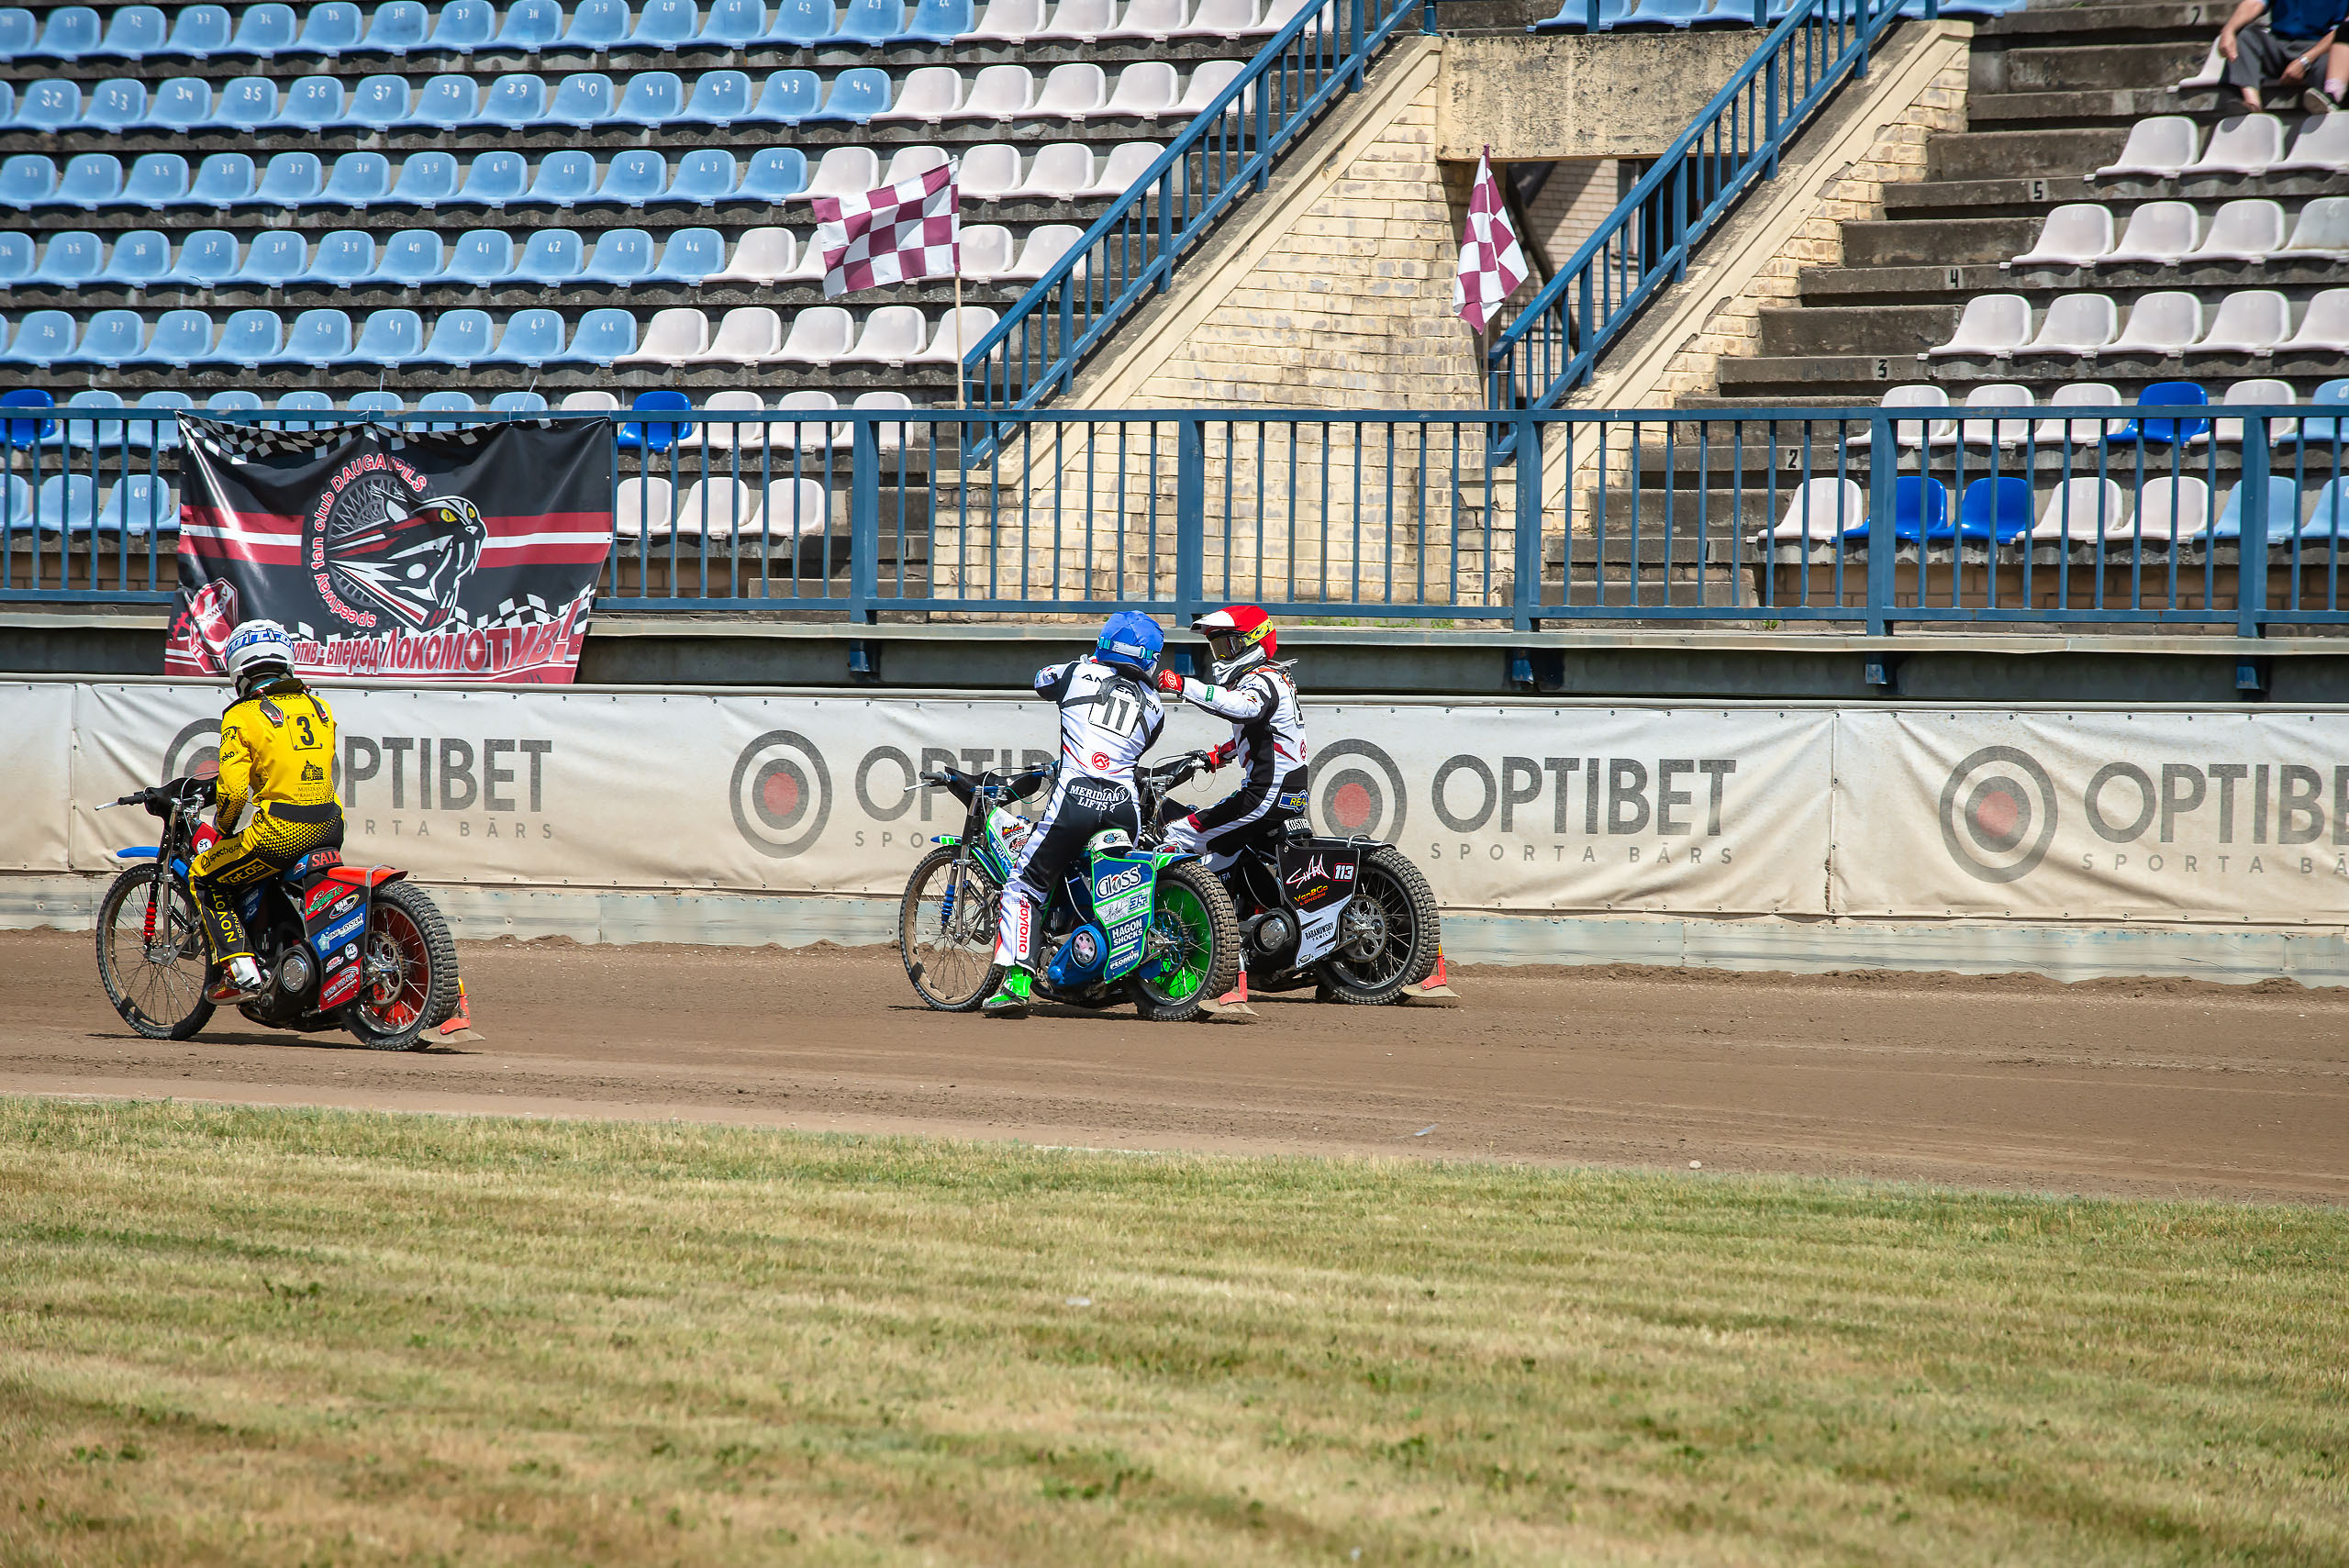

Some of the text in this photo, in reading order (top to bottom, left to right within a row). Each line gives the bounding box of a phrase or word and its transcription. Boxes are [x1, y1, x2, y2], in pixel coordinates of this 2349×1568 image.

[457, 8, 470, 20] 37
[594, 3, 608, 14] 39
[176, 86, 194, 102] 34
[243, 86, 262, 102] 35
[307, 85, 327, 99] 36
[373, 84, 392, 101] 37
[507, 83, 528, 98] 39
[578, 79, 598, 97] 40
[646, 83, 663, 96] 41
[712, 79, 732, 95] 42
[782, 80, 800, 94] 43
[853, 80, 871, 94] 44
[40, 89, 63, 108] 32
[109, 90, 129, 111] 33
[290, 163, 304, 175] 37
[422, 161, 440, 174] 39
[563, 164, 575, 174] 41
[700, 161, 718, 172] 43
[2034, 181, 2043, 200] 5
[477, 241, 490, 255] 41
[548, 240, 562, 253] 42
[617, 241, 635, 252] 43
[1950, 269, 1959, 288] 4
[460, 320, 473, 333] 42
[1878, 360, 1887, 379] 3
[1788, 449, 1798, 469] 2
[311, 453, 428, 628] speedway fan club DAUGAVPILS
[1101, 695, 1130, 731] 11
[296, 716, 315, 746] 3
[332, 735, 552, 813] PTIBET
[1069, 784, 1121, 802] MERIDIAN
[1431, 753, 1737, 837] OPTIBET
[1077, 796, 1108, 811] LIFTS
[459, 817, 552, 840] BĀRS
[1431, 842, 1732, 865] SPORTA BĀRS
[2082, 852, 2349, 875] SPORTA BĀ
[1335, 864, 1354, 880] 113
[1299, 892, 1327, 906] LONDON
[1111, 917, 1142, 940] HAGON
[1113, 929, 1143, 946] SHOCKS
